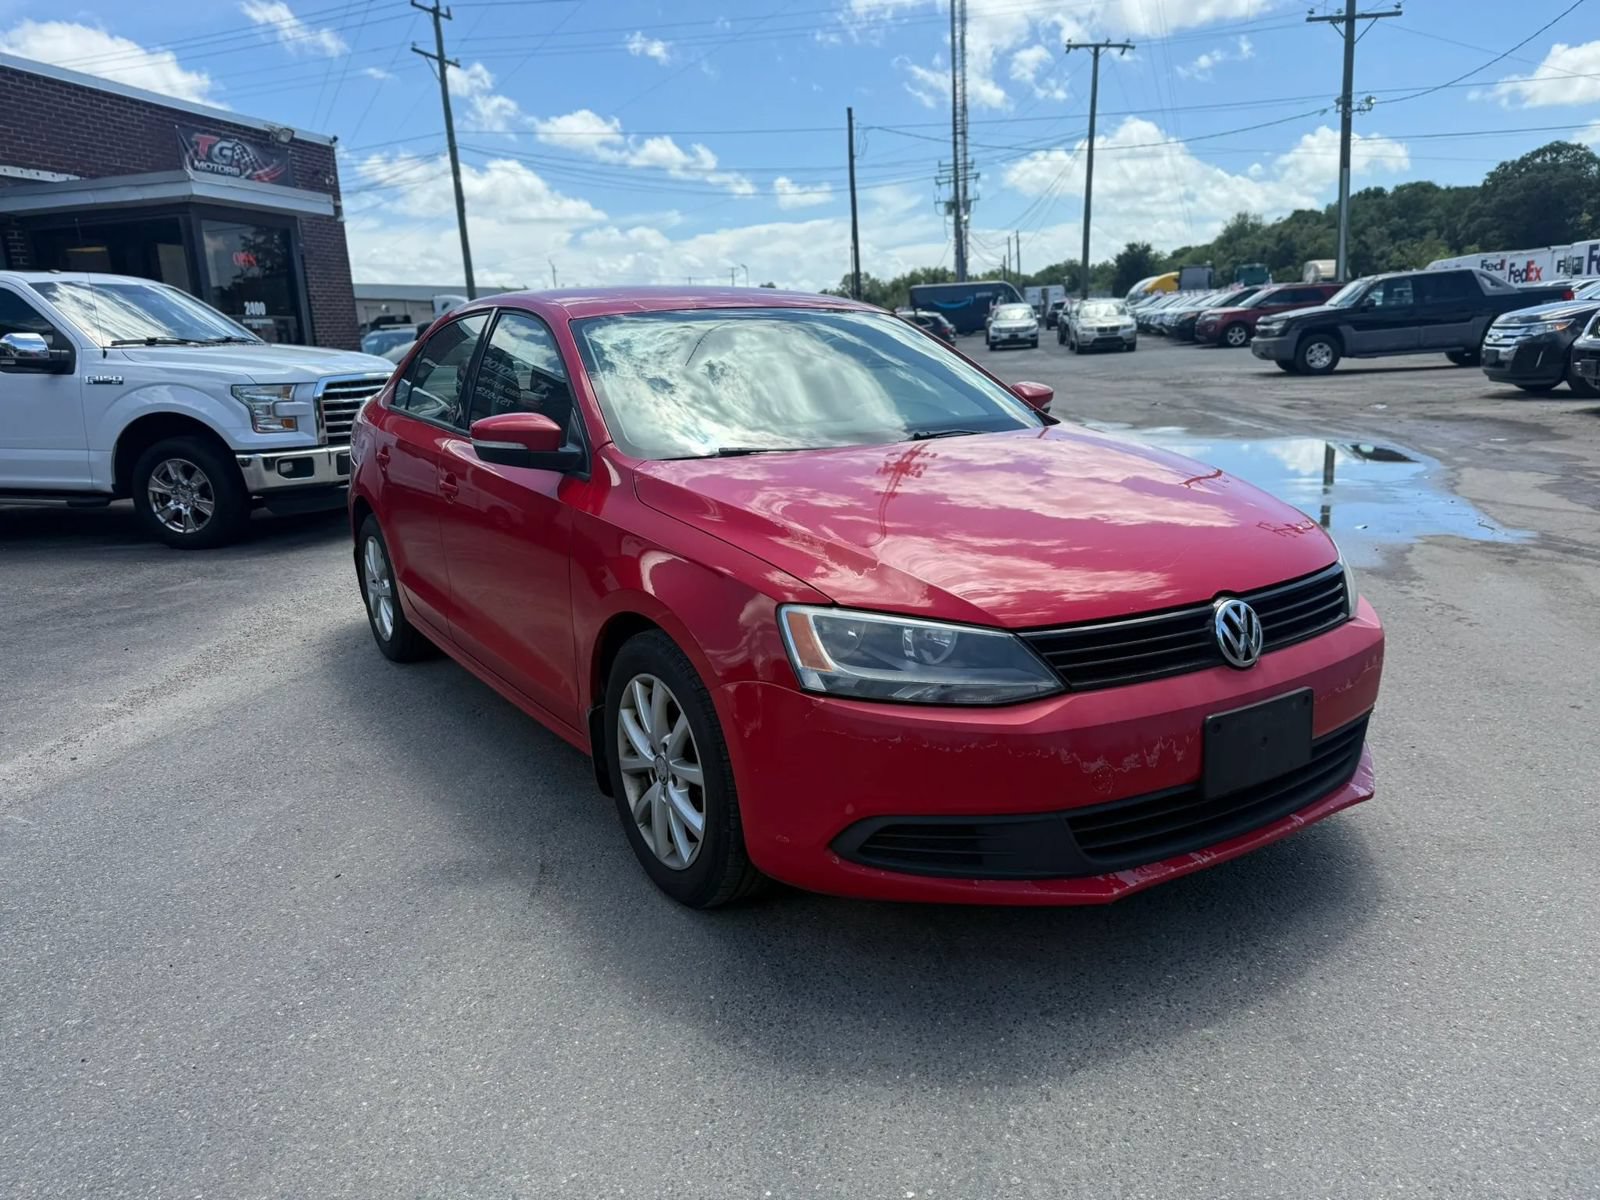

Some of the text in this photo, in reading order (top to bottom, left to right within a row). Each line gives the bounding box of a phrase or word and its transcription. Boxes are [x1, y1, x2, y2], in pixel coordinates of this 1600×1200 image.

[194, 160, 241, 176] MOTORS
[1508, 259, 1543, 283] FedEx
[244, 301, 266, 316] 2400
[1215, 600, 1263, 667] VW
